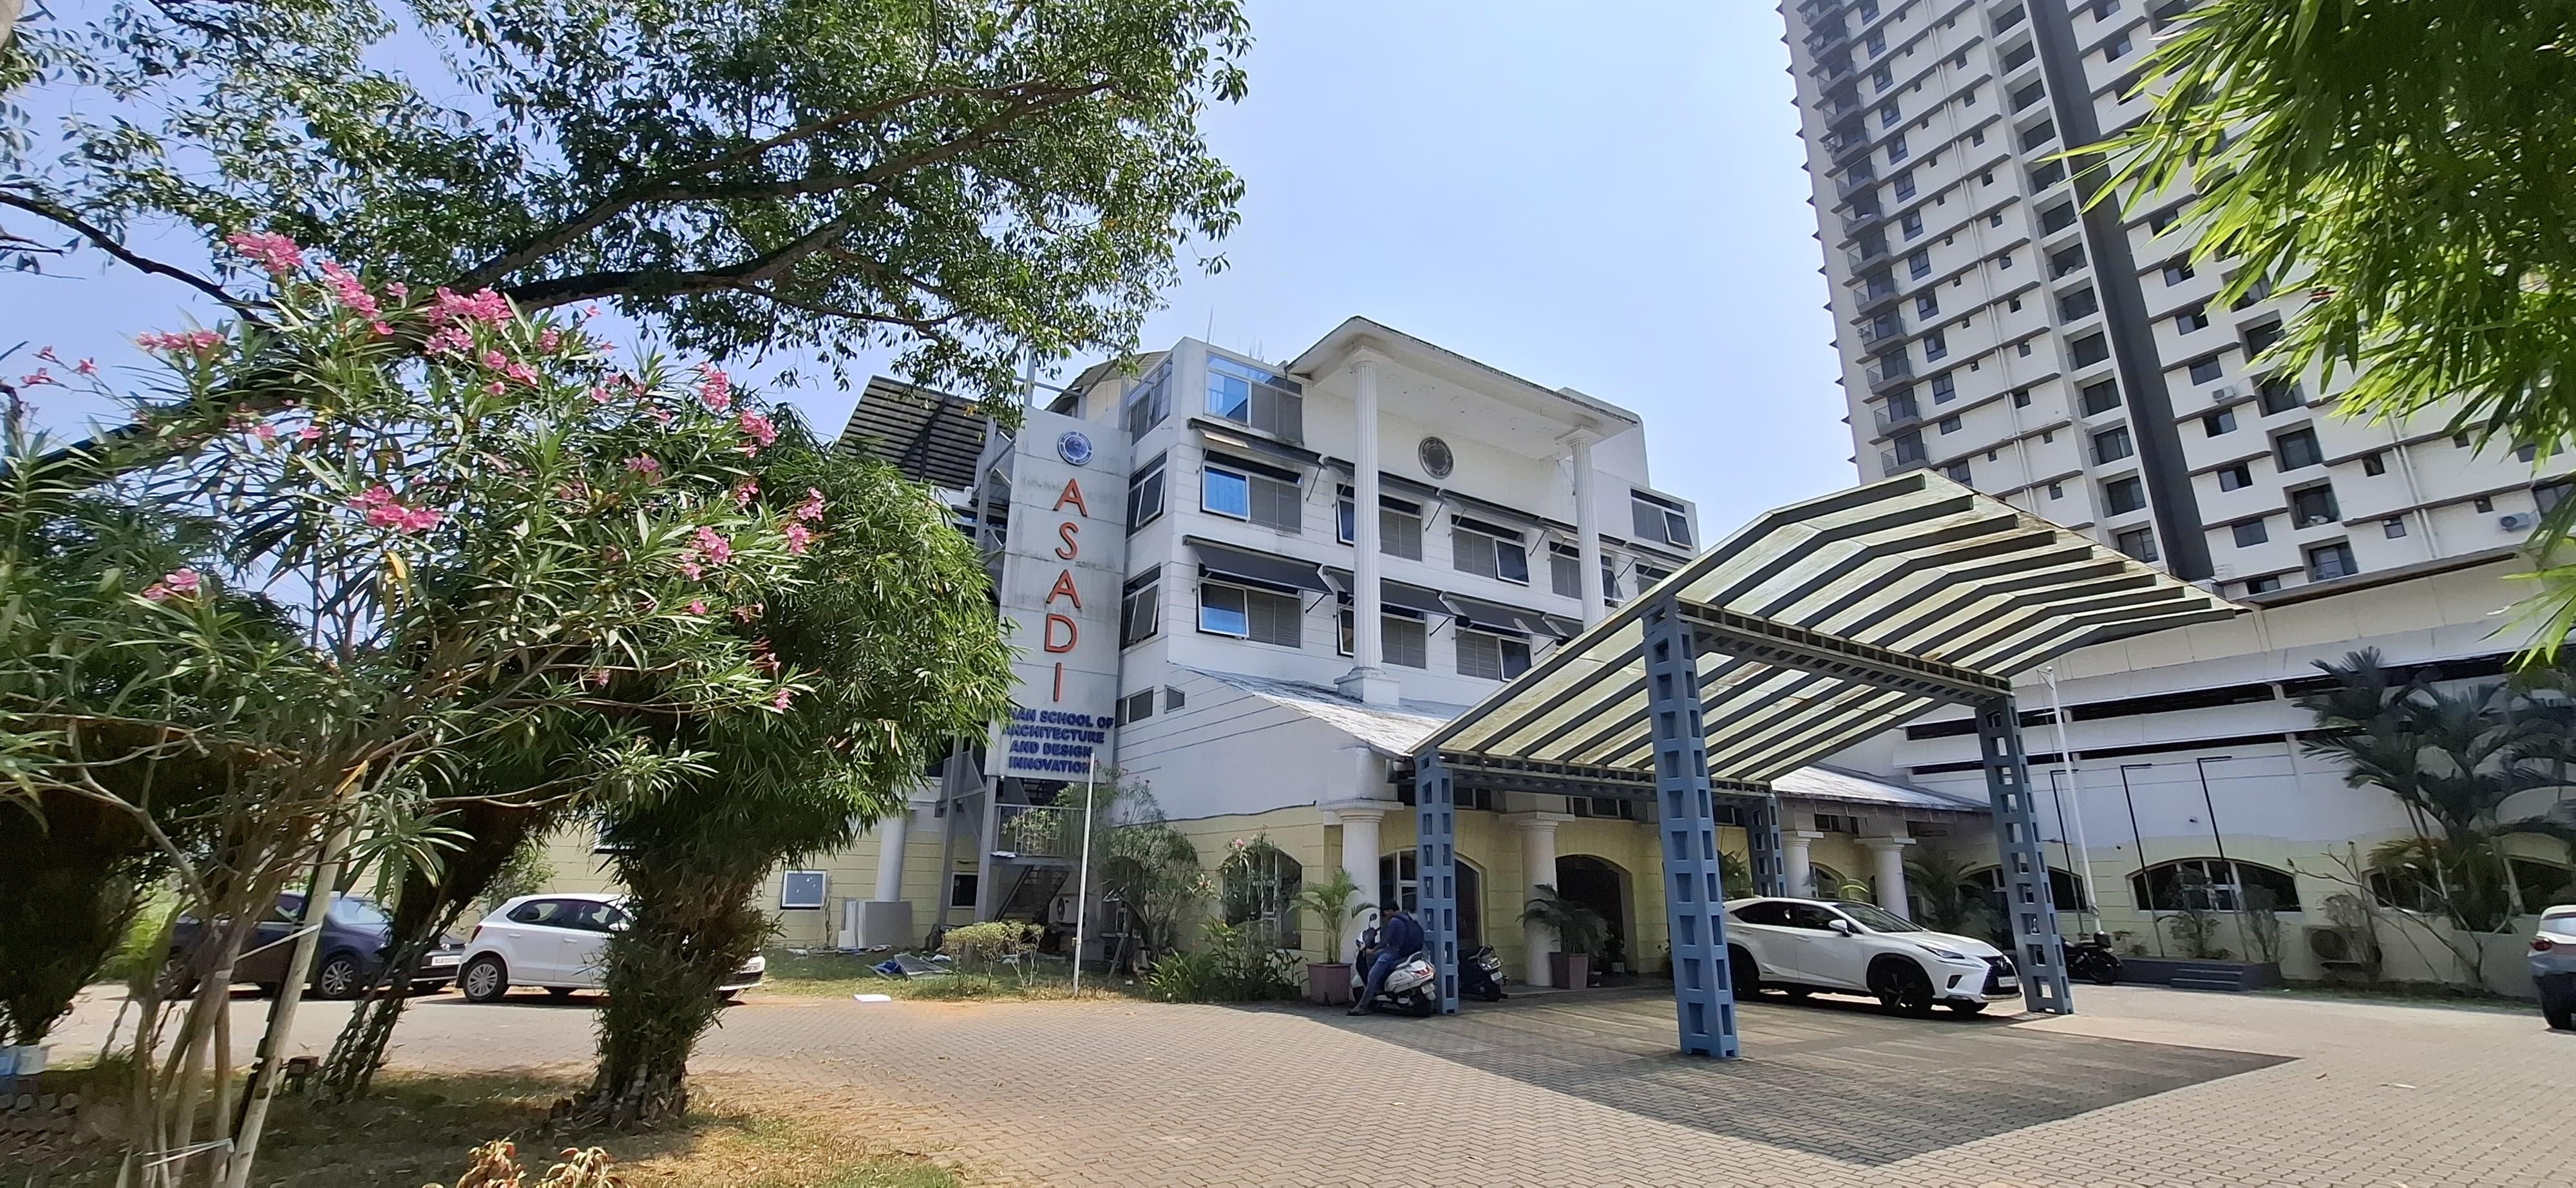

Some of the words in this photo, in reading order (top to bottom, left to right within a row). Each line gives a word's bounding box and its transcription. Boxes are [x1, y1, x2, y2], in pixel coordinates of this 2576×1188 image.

[1044, 477, 1088, 703] ASADI
[1039, 710, 1093, 727] SCHOOL
[1096, 716, 1114, 729] OF
[1010, 740, 1039, 754] AND
[1043, 742, 1093, 757] DESIGN
[1009, 756, 1092, 773] INNOVATION
